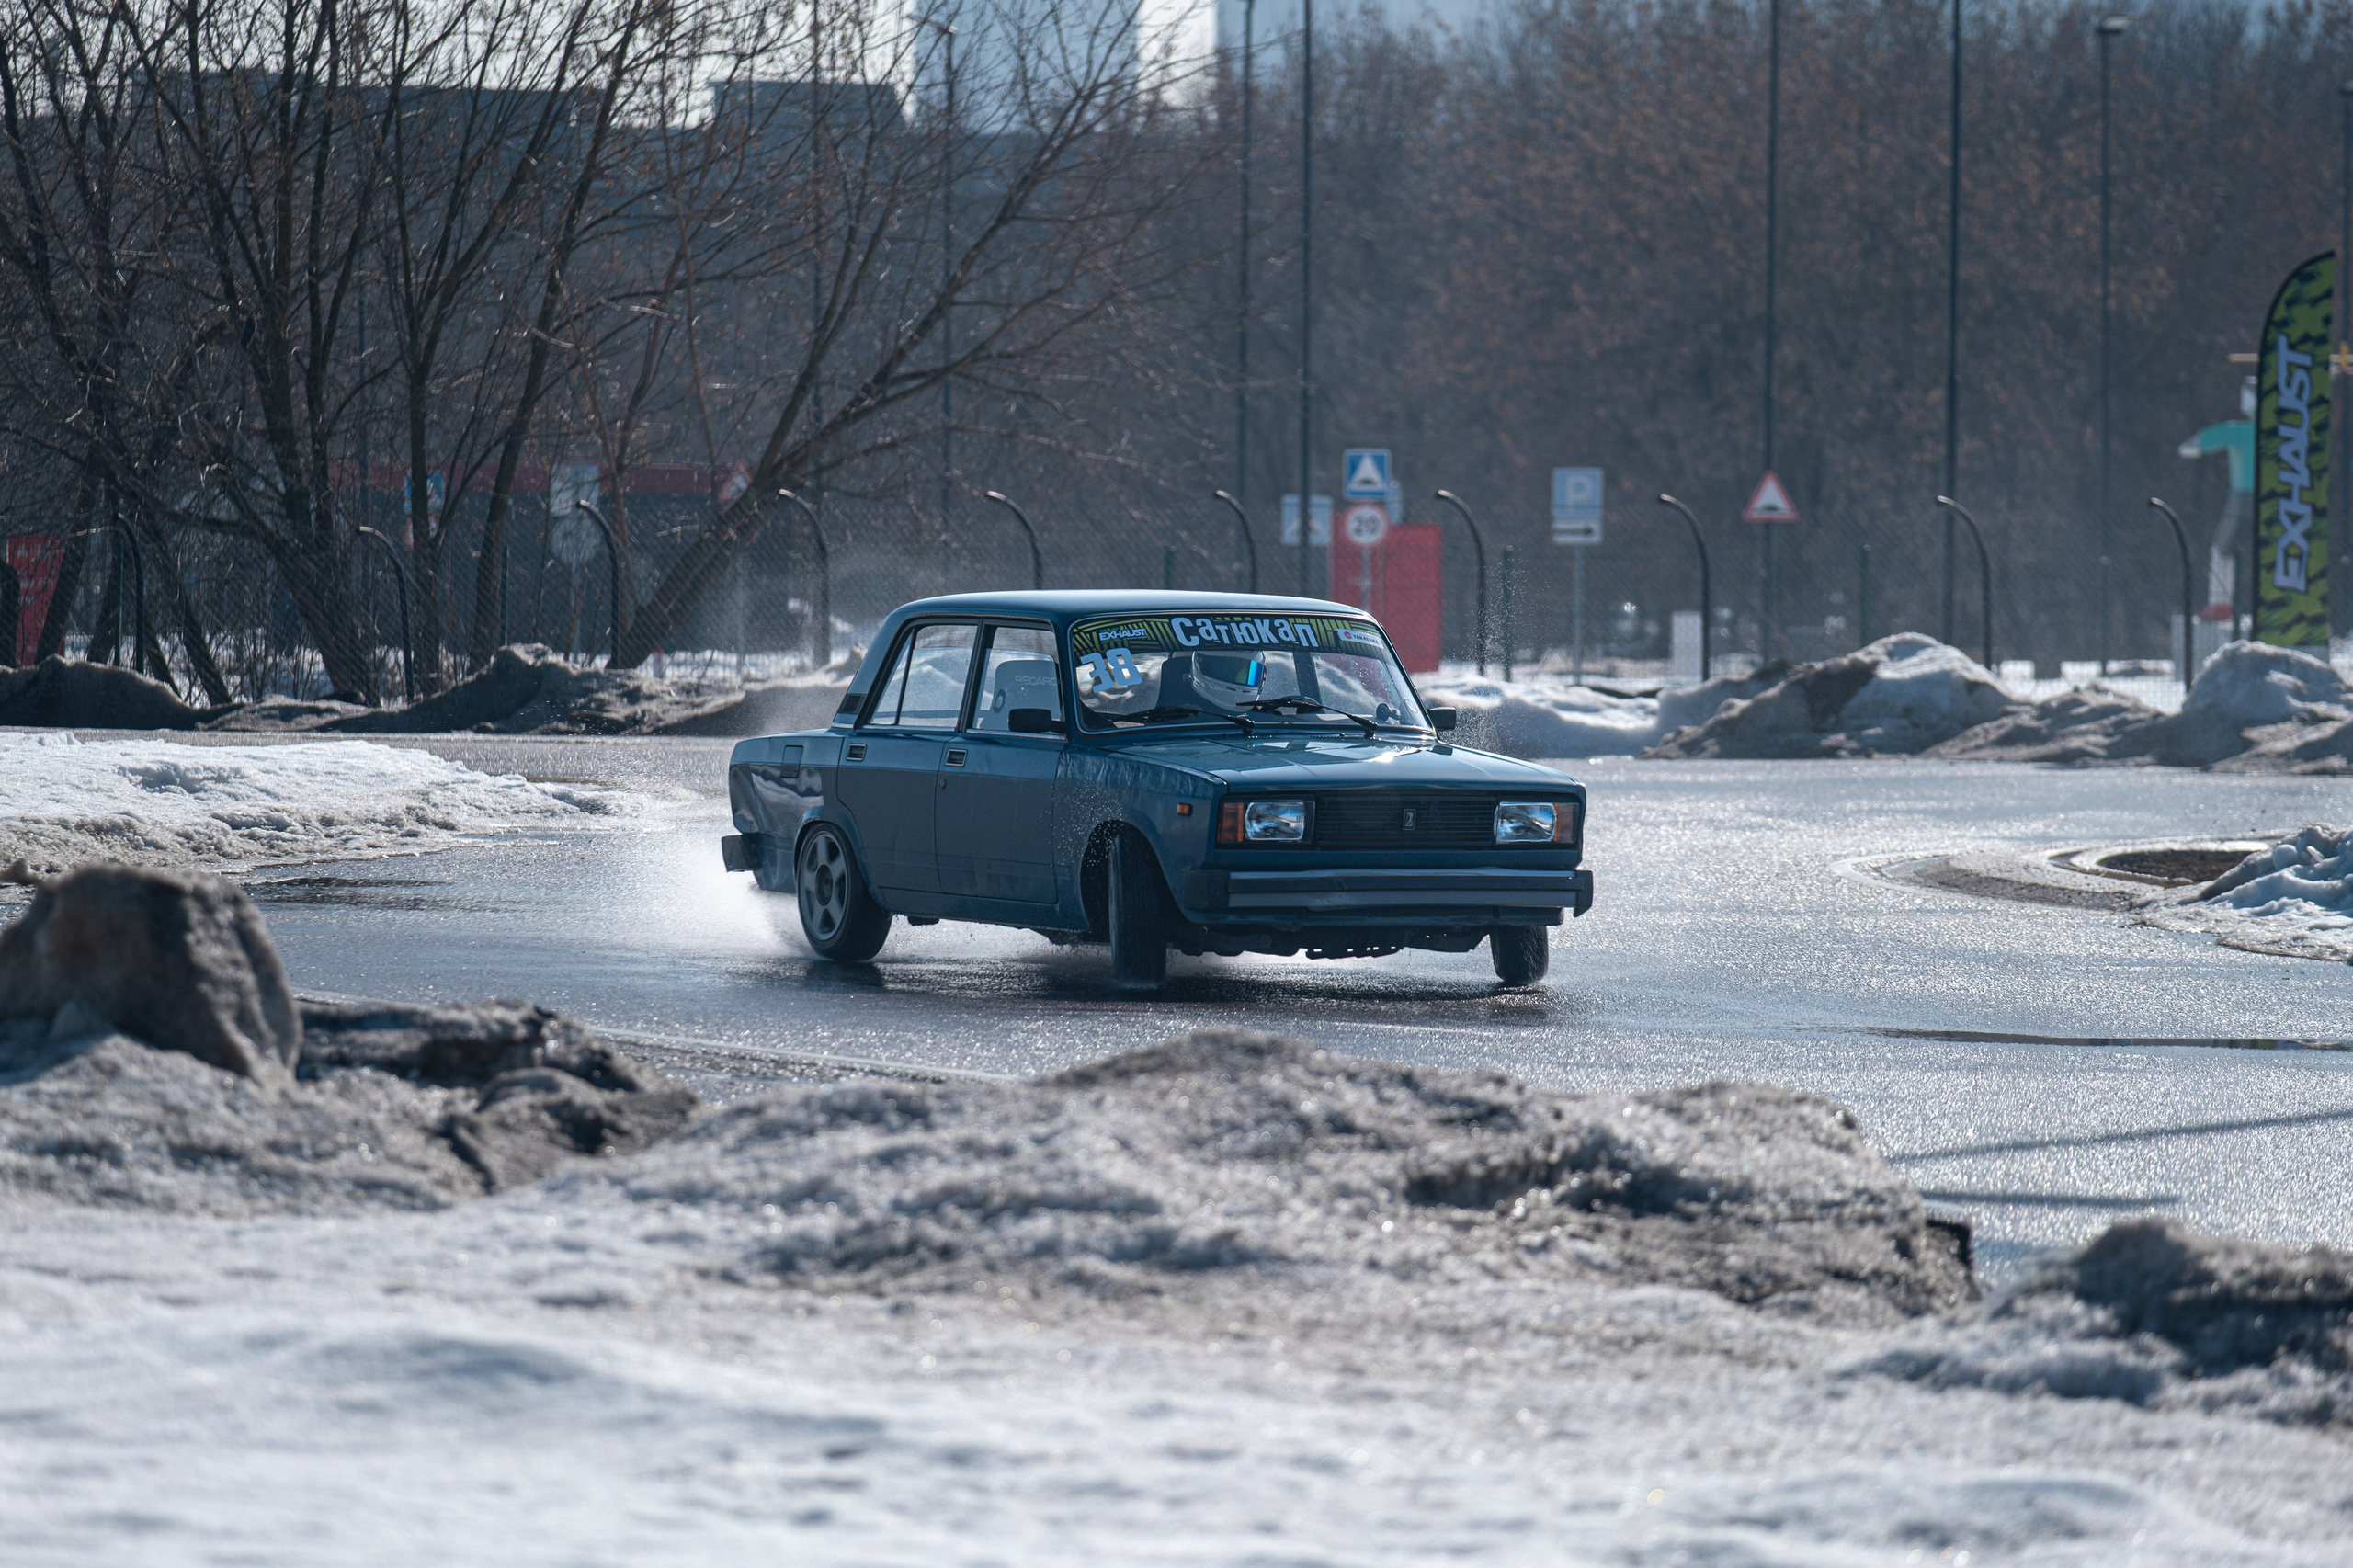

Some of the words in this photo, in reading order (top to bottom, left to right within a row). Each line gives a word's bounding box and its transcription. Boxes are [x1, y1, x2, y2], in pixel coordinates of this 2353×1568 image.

[2274, 333, 2313, 592] EXHAUST
[1565, 474, 1594, 515] P
[1353, 515, 1381, 537] 20
[1099, 628, 1146, 642] EXHAUST
[1080, 647, 1142, 693] 38
